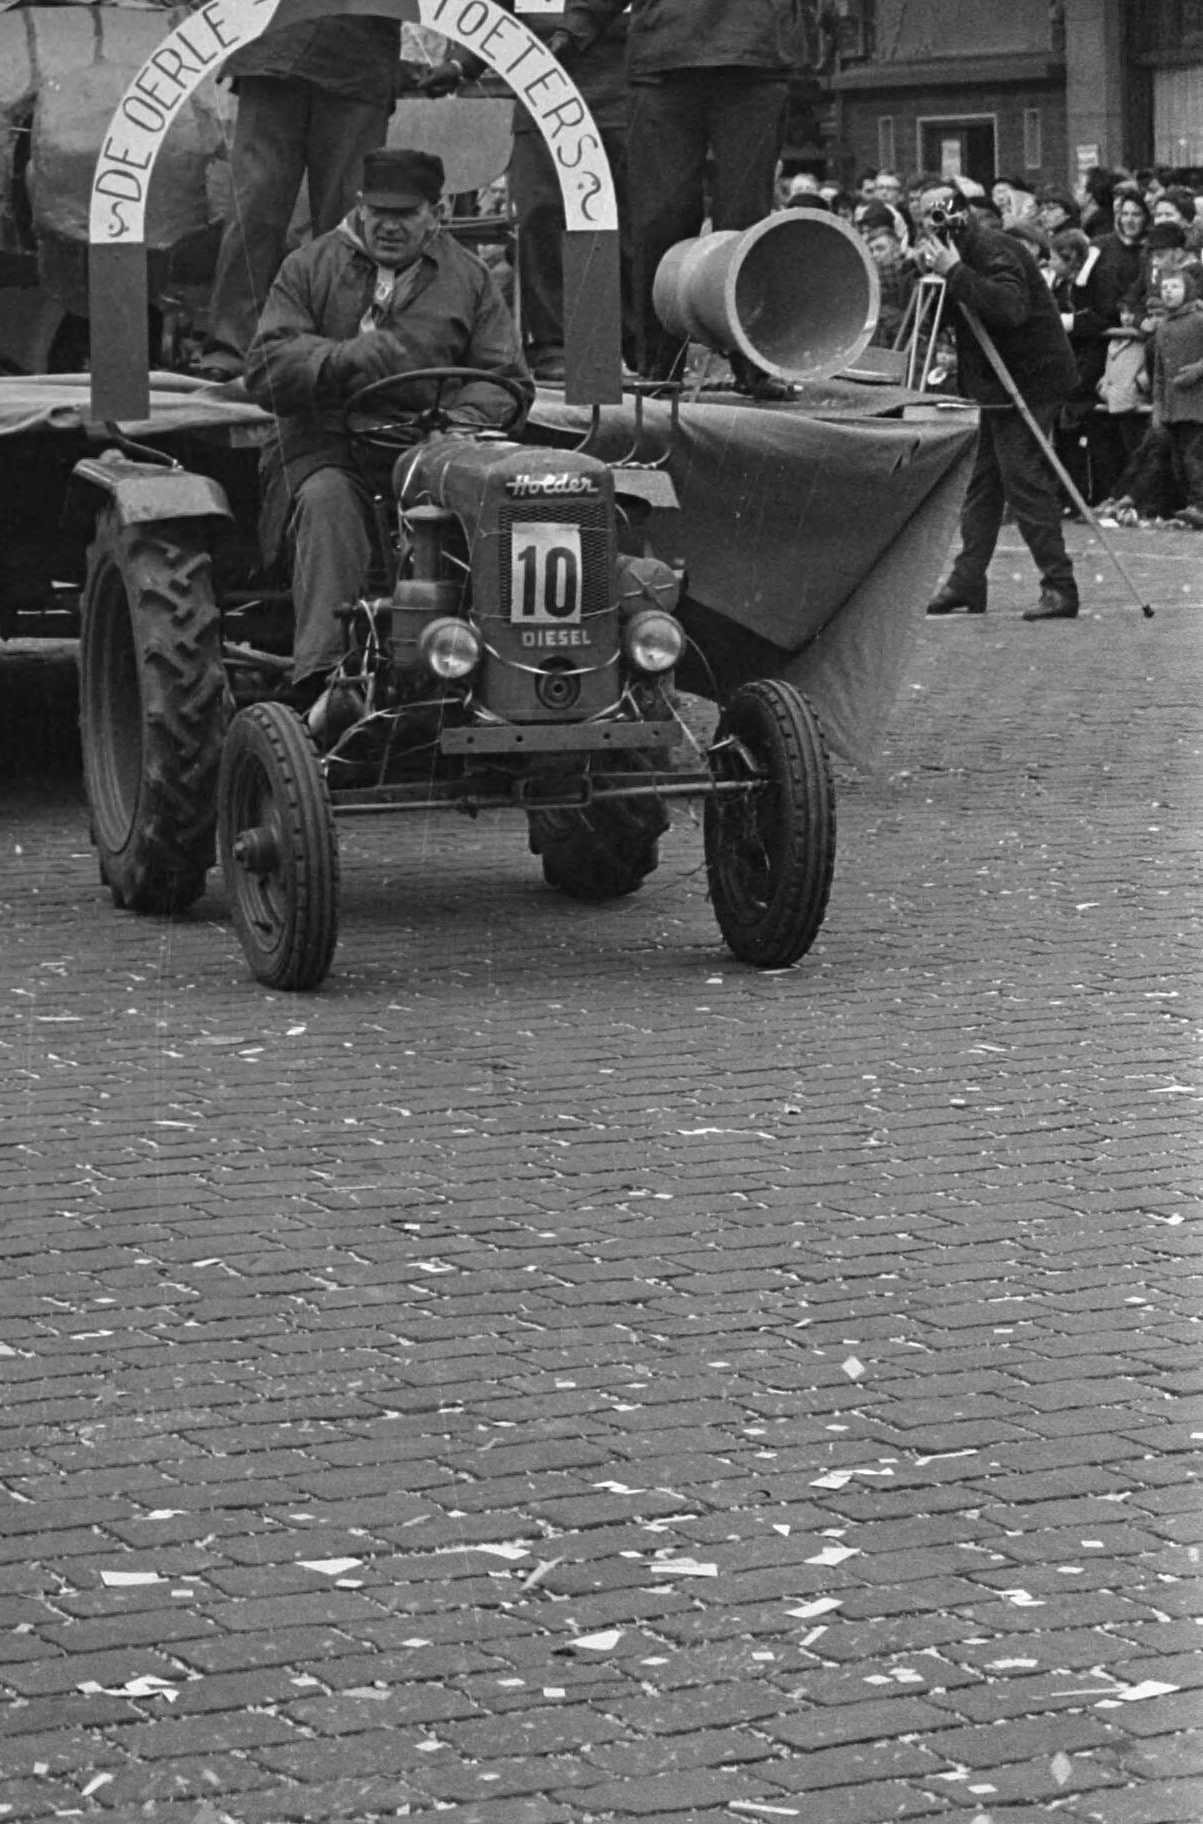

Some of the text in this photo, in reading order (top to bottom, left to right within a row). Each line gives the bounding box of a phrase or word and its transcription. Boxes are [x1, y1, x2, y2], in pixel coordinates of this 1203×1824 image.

[121, 1, 241, 133] OERLE
[95, 136, 153, 203] DE
[506, 474, 599, 497] Holder
[518, 545, 577, 618] 10
[521, 629, 592, 648] DIESEL
